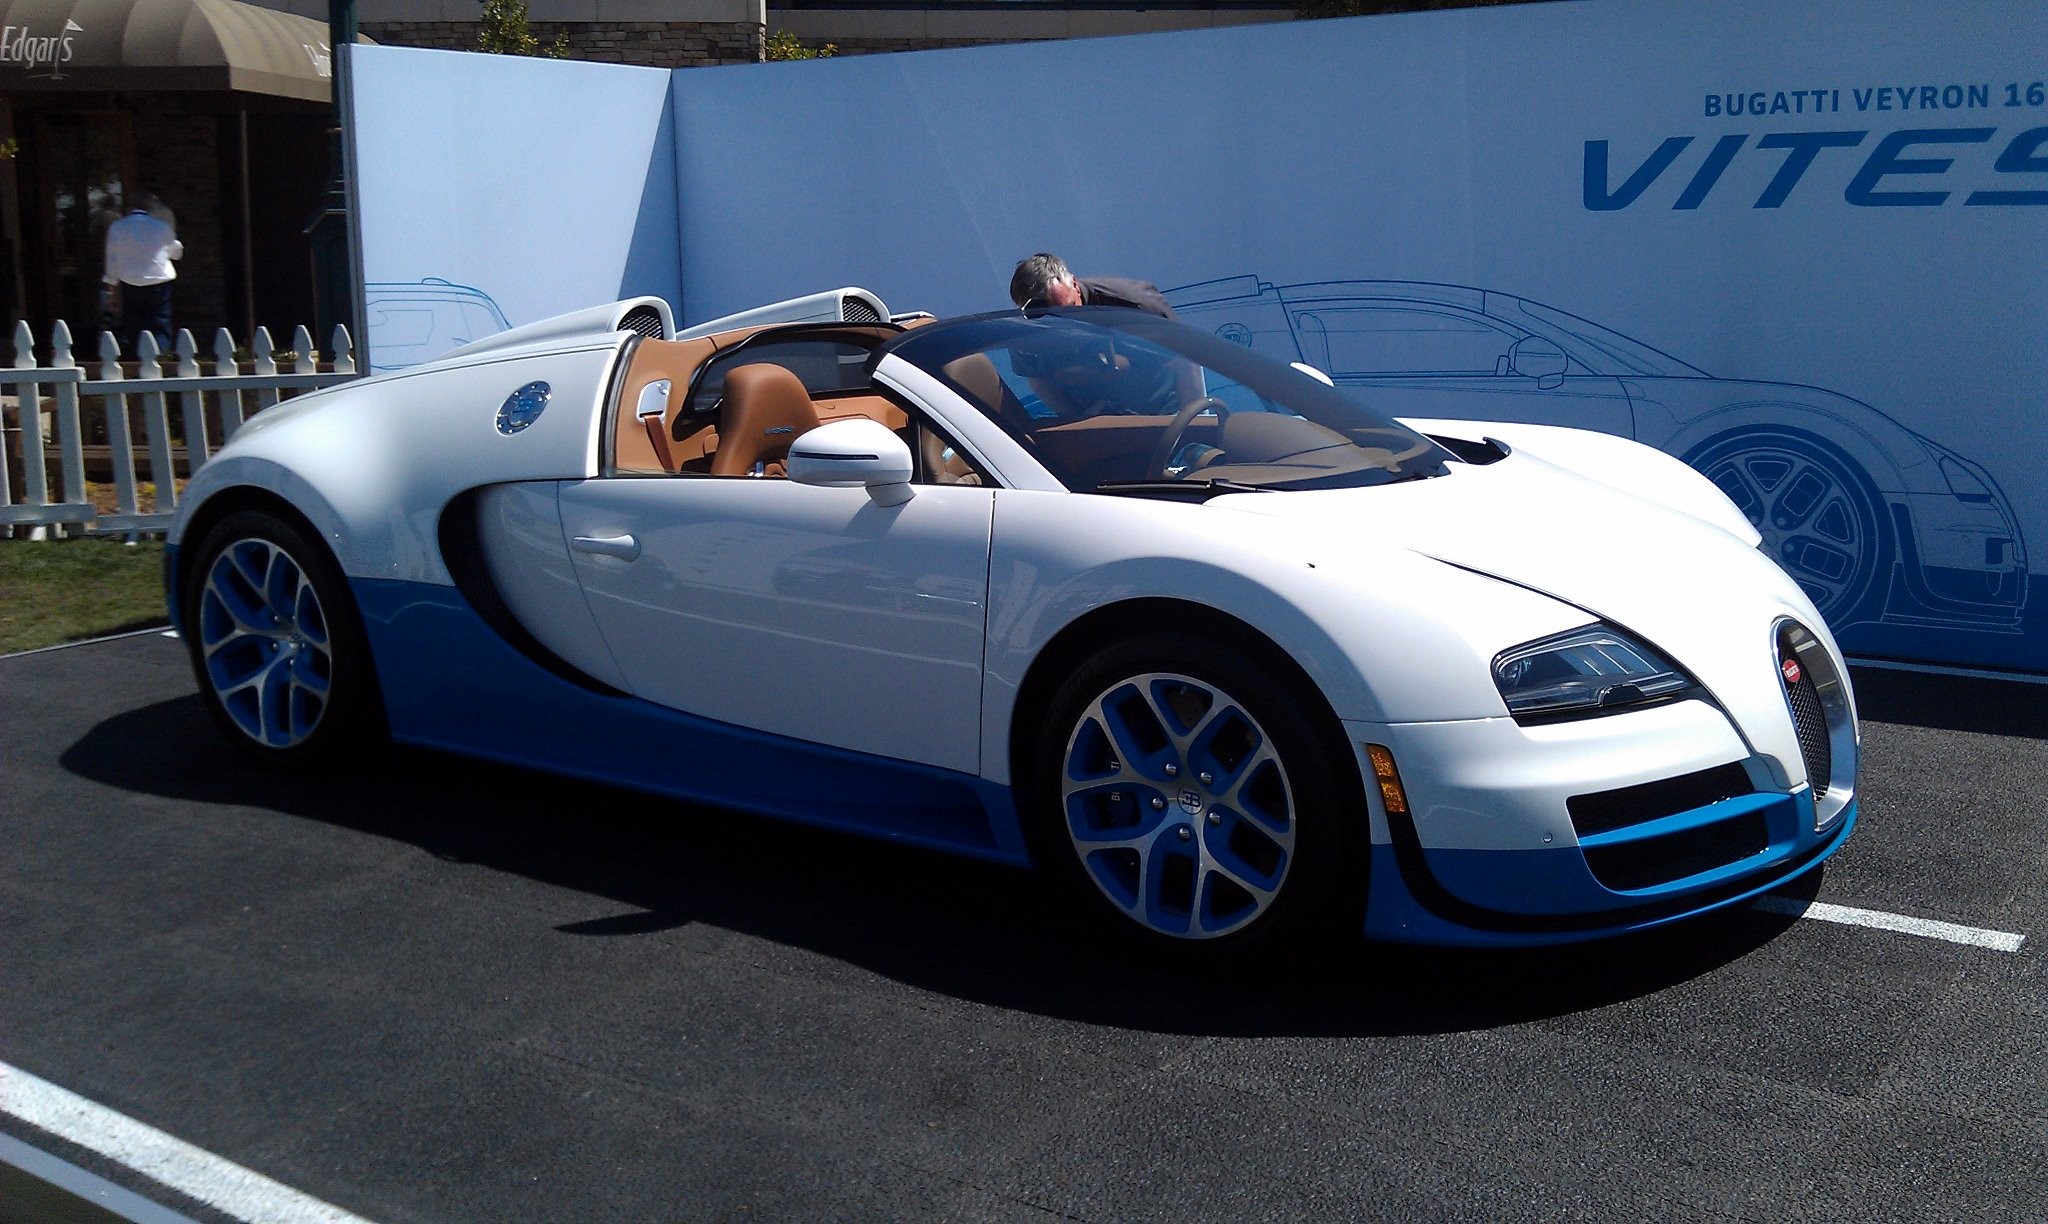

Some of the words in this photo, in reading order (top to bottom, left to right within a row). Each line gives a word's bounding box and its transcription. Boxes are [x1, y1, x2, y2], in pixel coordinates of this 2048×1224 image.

[1704, 89, 1840, 118] BUGATTI
[1853, 84, 1990, 112] VEYRON
[2003, 81, 2046, 108] 16
